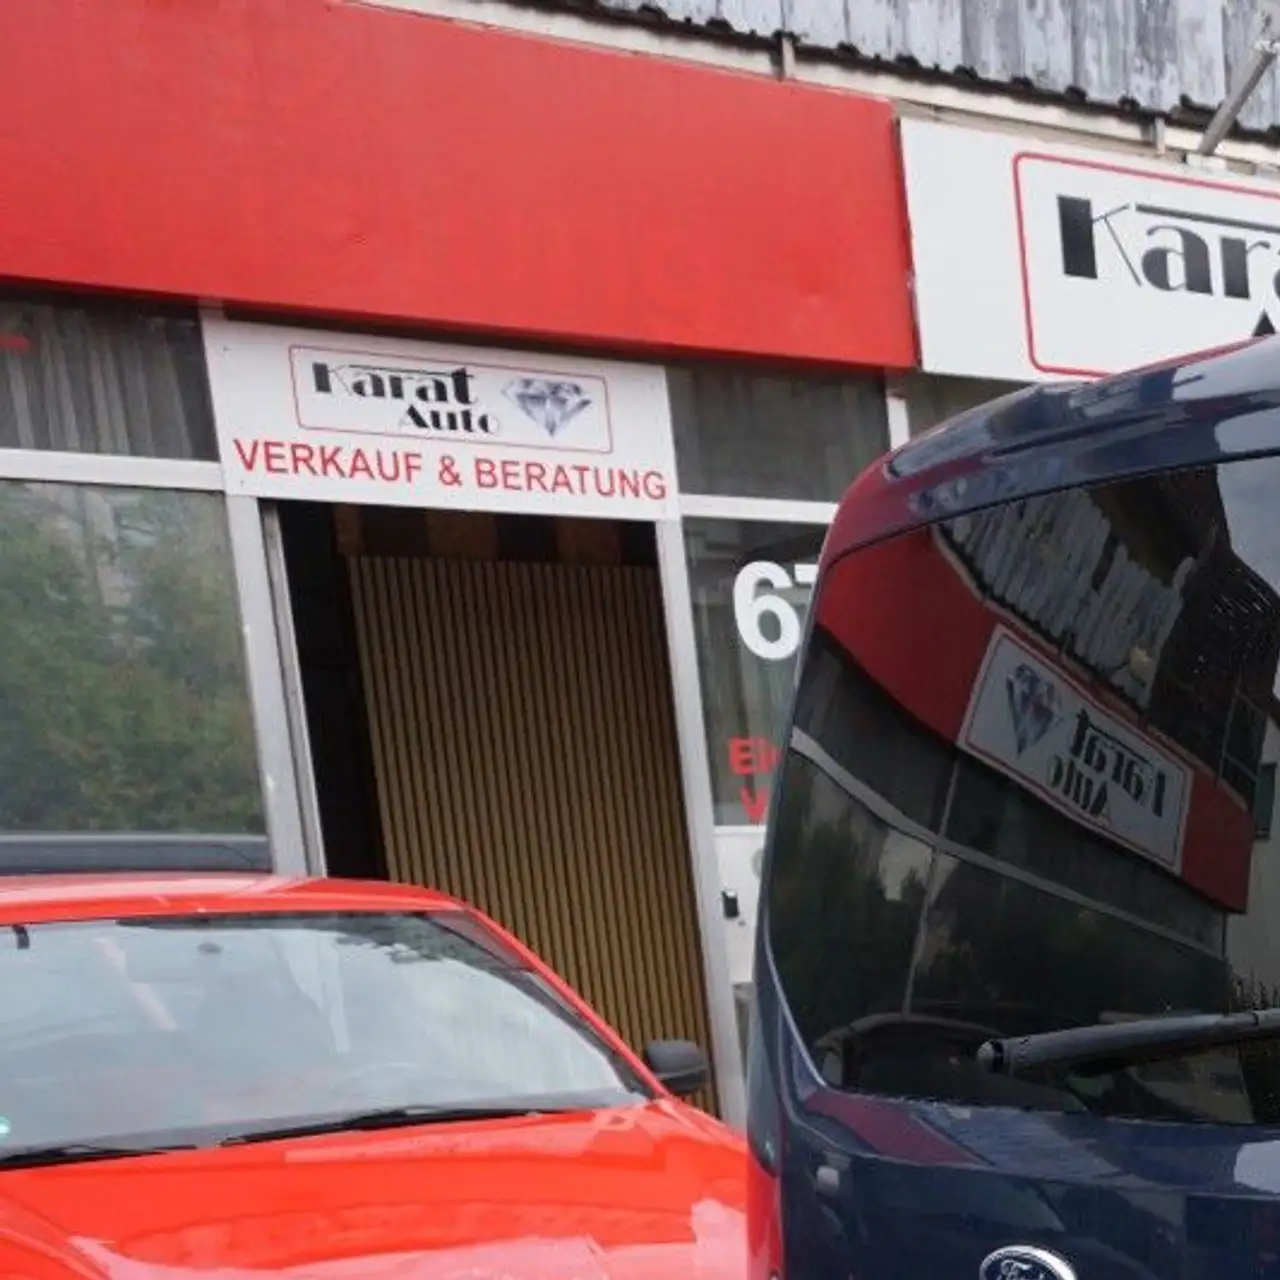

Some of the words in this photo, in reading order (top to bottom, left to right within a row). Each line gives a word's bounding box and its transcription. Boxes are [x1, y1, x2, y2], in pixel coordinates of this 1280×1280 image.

[311, 362, 477, 406] Karat
[402, 404, 500, 434] Auto
[233, 438, 422, 483] VERKAUF
[438, 458, 461, 487] &
[474, 457, 667, 501] BERATUNG
